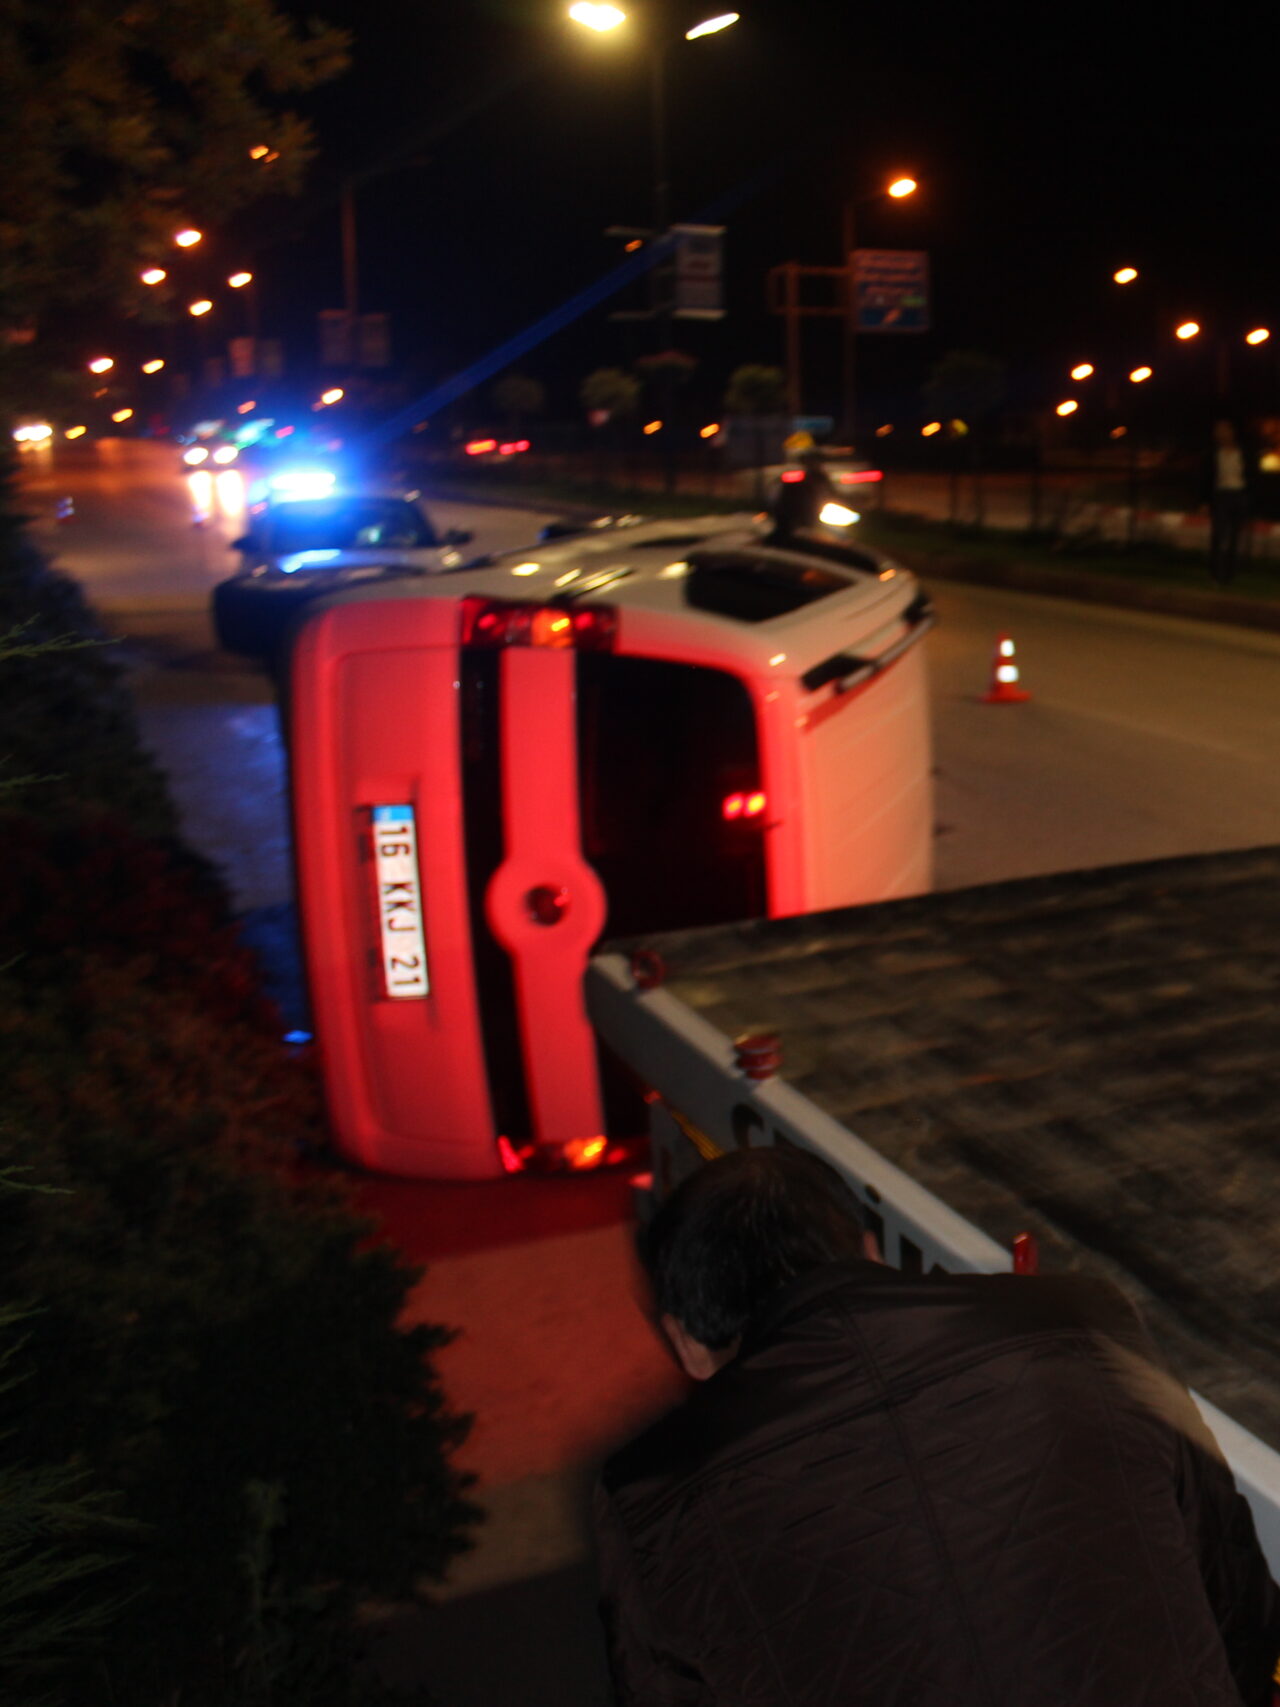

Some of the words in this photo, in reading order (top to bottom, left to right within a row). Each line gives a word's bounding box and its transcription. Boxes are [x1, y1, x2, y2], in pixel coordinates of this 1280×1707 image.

[378, 825, 411, 858] 16
[382, 881, 418, 932] KKJ
[391, 955, 422, 986] 21
